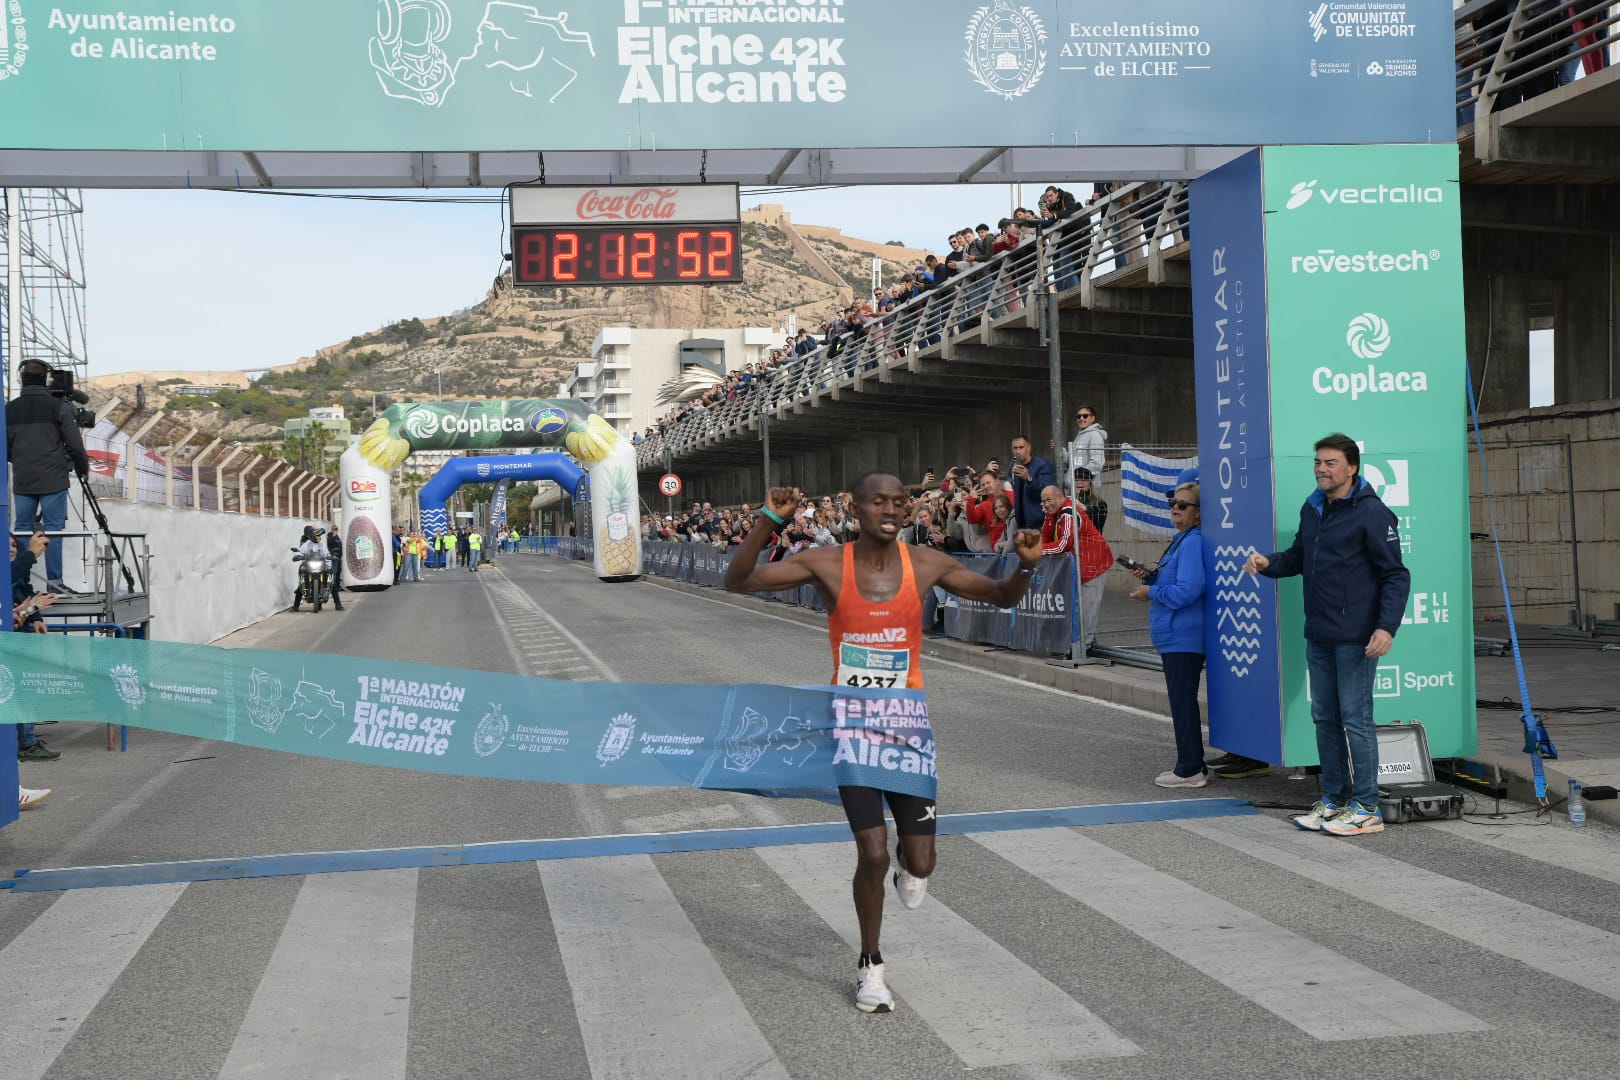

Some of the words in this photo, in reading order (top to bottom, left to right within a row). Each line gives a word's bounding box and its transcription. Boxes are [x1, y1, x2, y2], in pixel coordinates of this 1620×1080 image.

[668, 7, 845, 23] INTERNACIONAL
[1330, 2, 1366, 10] Comunitat
[1368, 2, 1406, 10] Valenciana
[48, 8, 235, 35] Ayuntamiento
[1330, 12, 1406, 24] COMUNITAT
[1070, 21, 1200, 37] Excelentísimo
[1336, 25, 1353, 37] DE
[1356, 24, 1416, 37] L'ESPORT
[71, 36, 103, 58] de
[110, 37, 217, 60] Alicante
[617, 26, 764, 65] Elche
[770, 37, 846, 65] 42K
[1059, 41, 1211, 57] AYUNTAMIENTO
[1094, 61, 1115, 76] de
[1121, 62, 1178, 76] ELCHE
[617, 57, 847, 104] Alicante
[576, 188, 679, 220] Coca-Cola
[1213, 246, 1234, 528] MONTEMAR
[1313, 364, 1428, 400] Coplaca
[442, 414, 525, 437] Coplaca
[1239, 422, 1248, 489] CLUB
[352, 481, 377, 491] Dole
[664, 481, 677, 489] 30
[491, 485, 505, 526] Alicante
[358, 675, 380, 700] 1ª
[382, 680, 466, 702] MARATÓN
[847, 675, 898, 688] 4237
[1404, 671, 1455, 691] Sport
[160, 692, 173, 700] de
[380, 694, 461, 713] INTERNACIONAL
[353, 701, 418, 730] Elche
[420, 717, 456, 736] 42K
[347, 720, 449, 756] Alicante
[510, 733, 569, 746] AYUNTAMIENTO
[639, 732, 705, 745] Ayuntamiento
[641, 746, 654, 755] de
[655, 746, 694, 756] Alicante
